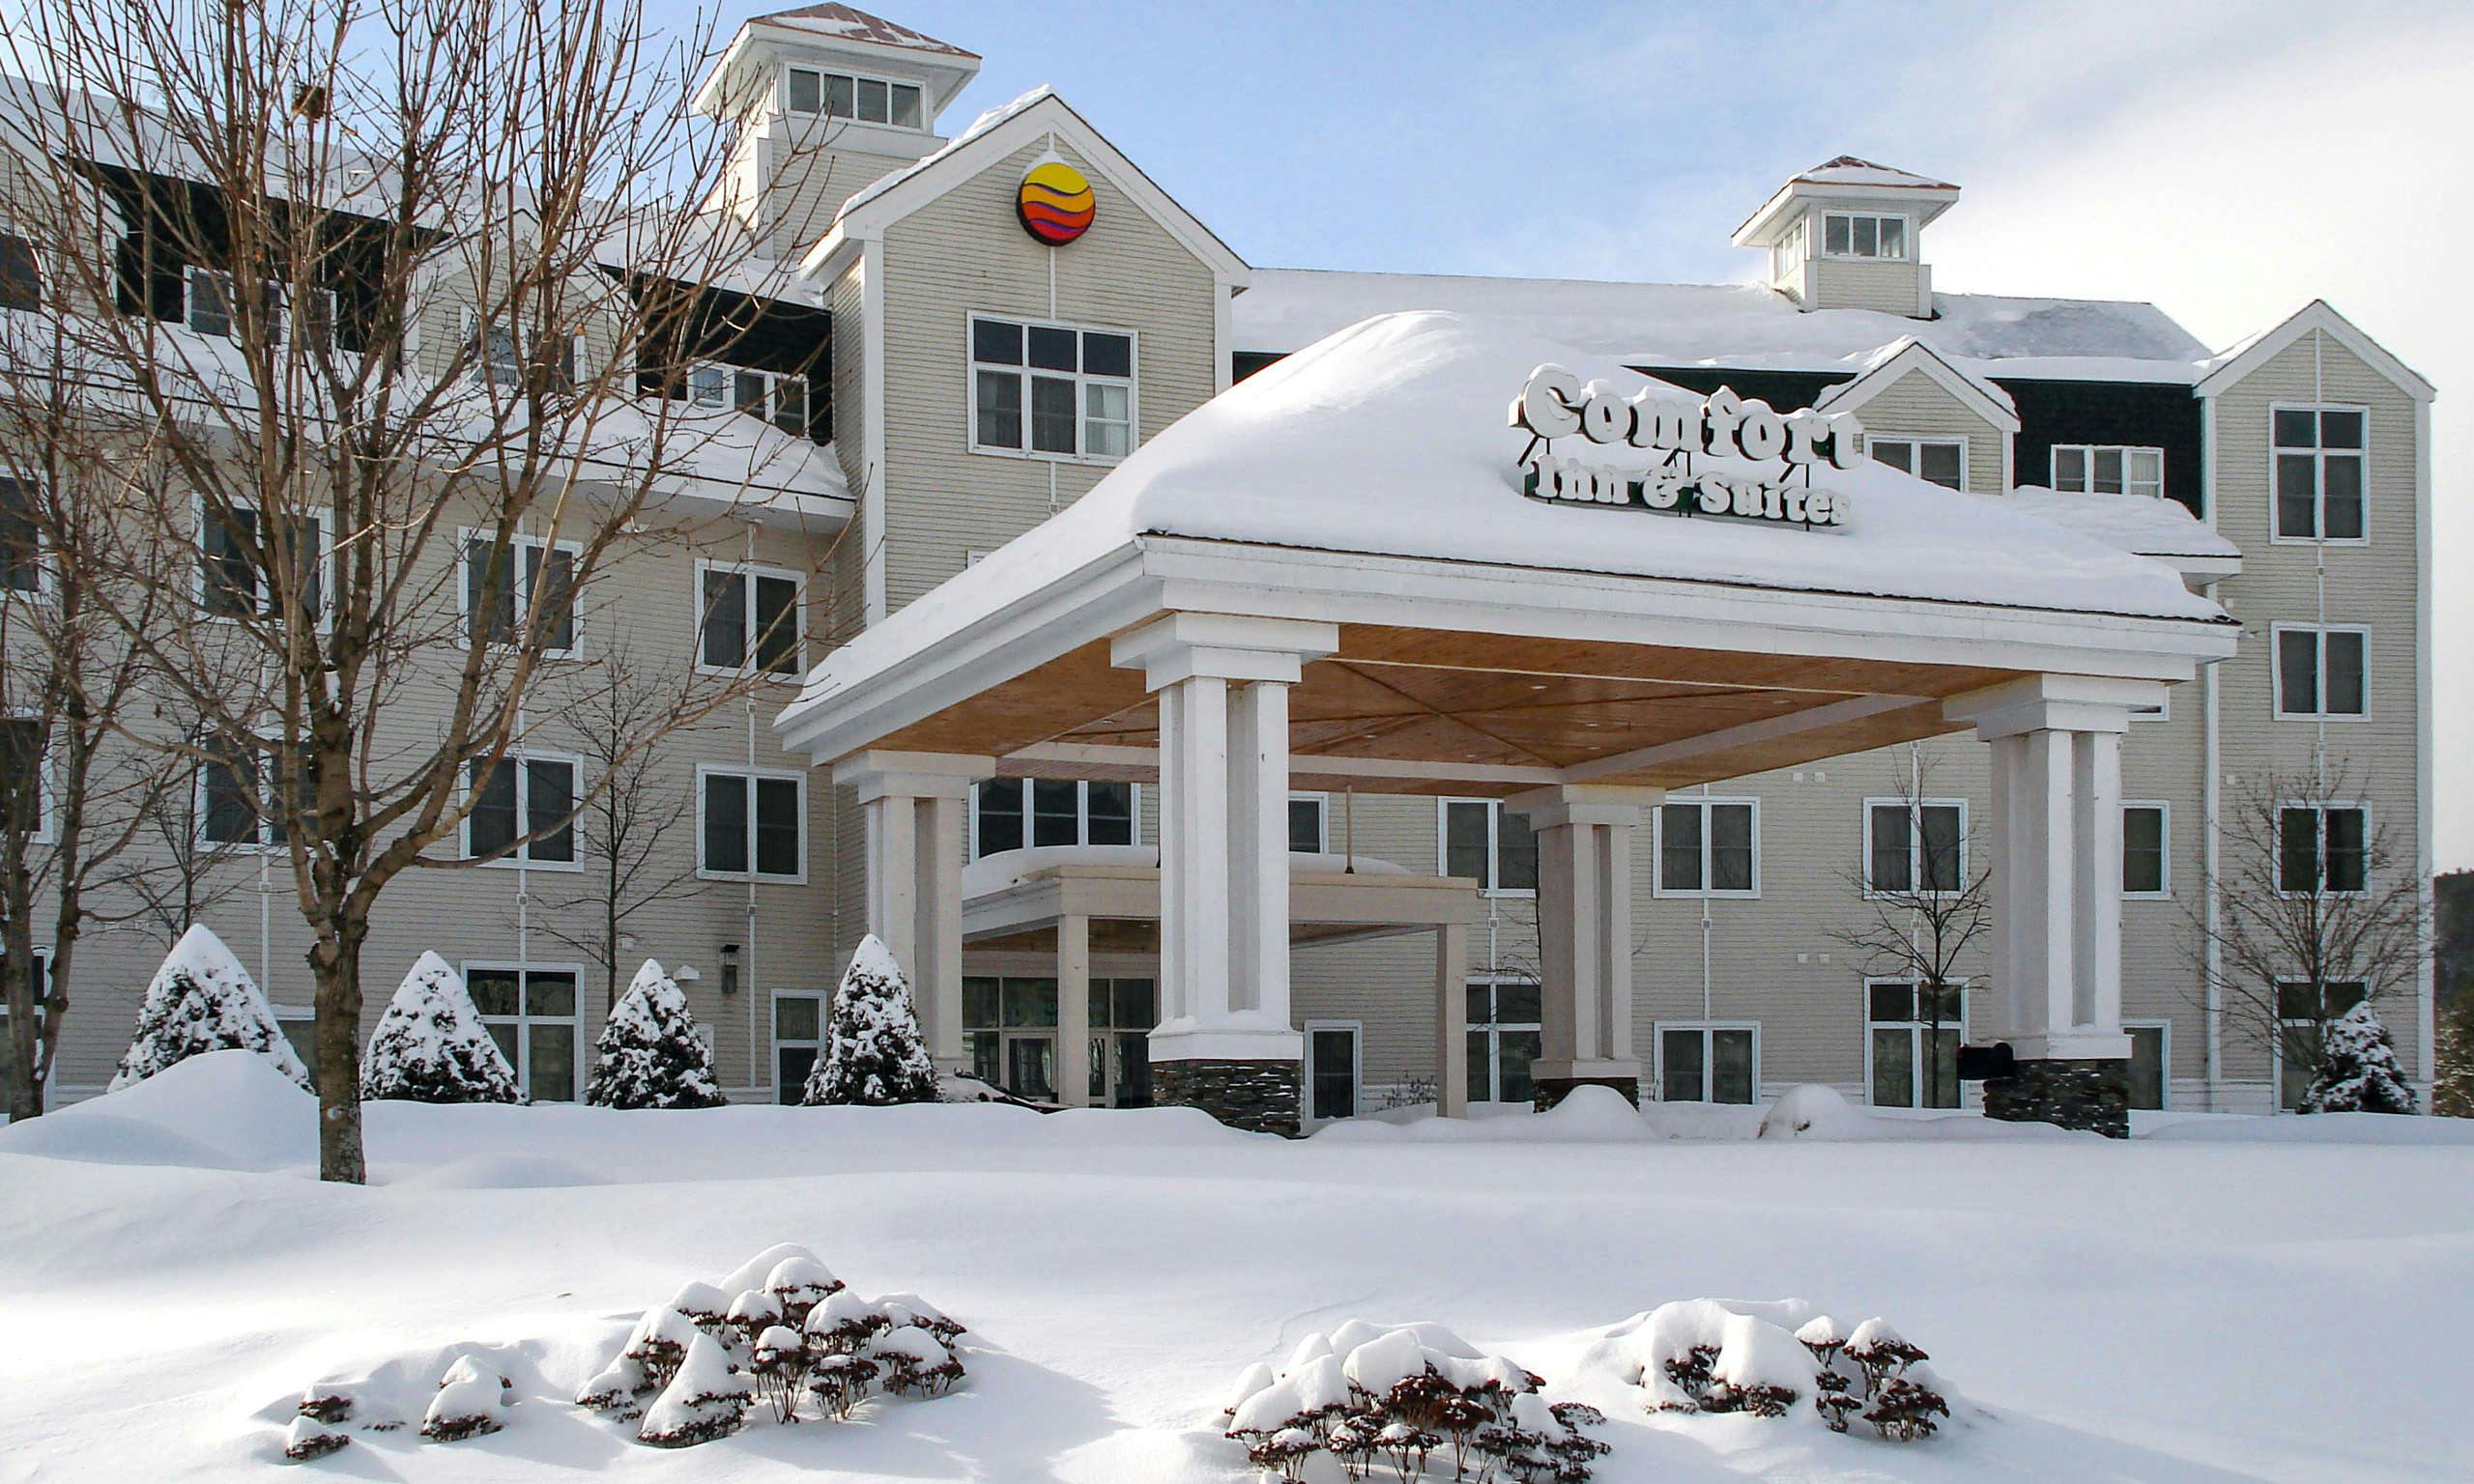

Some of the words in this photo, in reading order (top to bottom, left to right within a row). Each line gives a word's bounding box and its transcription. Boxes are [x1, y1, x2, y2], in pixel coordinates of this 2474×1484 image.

[1523, 363, 1864, 471] Comfort
[1533, 454, 1630, 505] Inn
[1643, 467, 1680, 509] &
[1698, 472, 1852, 525] Suites
